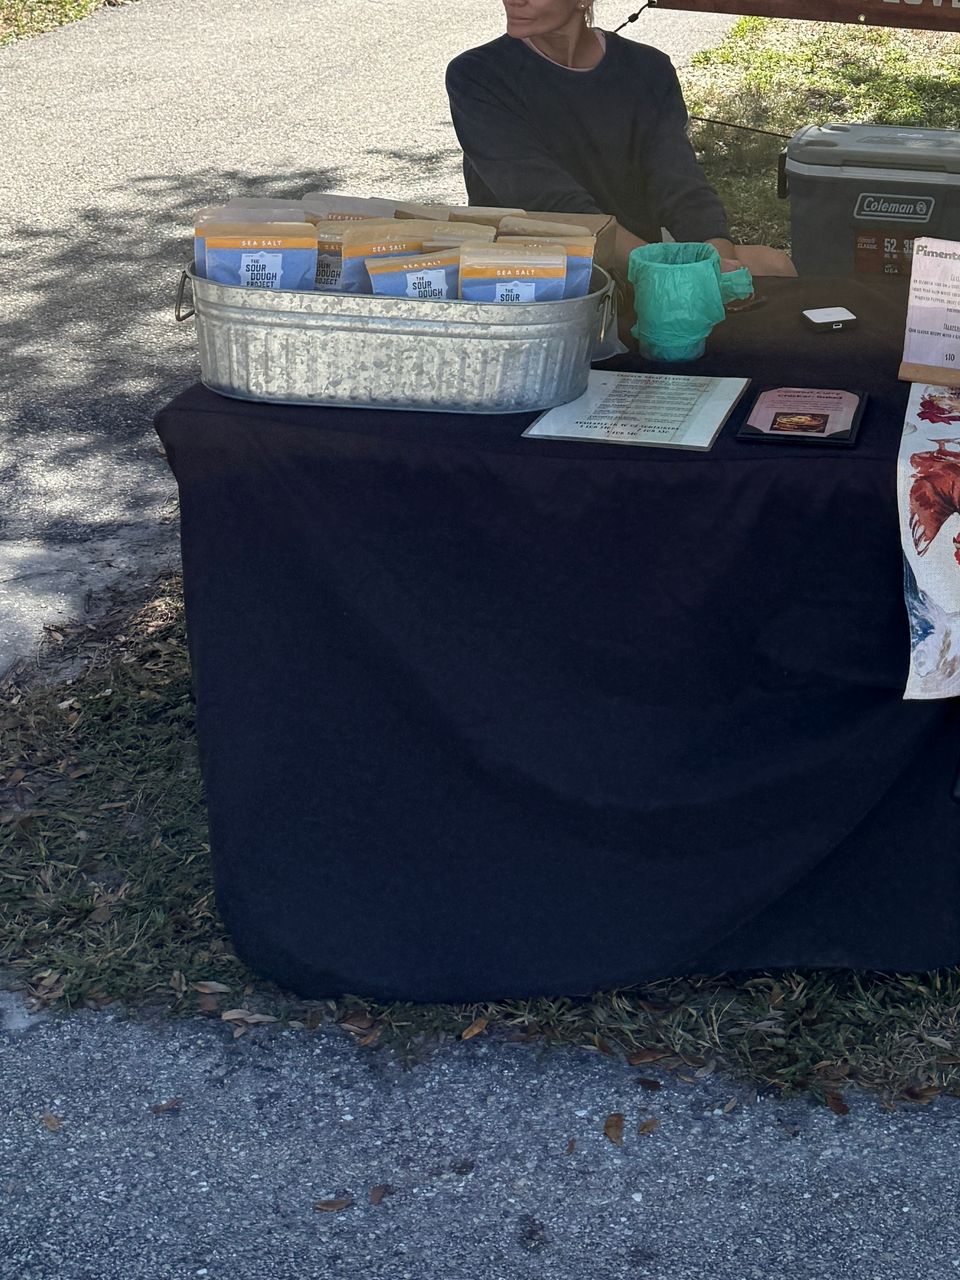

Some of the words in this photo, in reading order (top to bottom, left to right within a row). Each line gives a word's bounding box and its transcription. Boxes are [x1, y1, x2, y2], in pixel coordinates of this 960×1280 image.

[864, 197, 914, 213] Coleman
[884, 238, 897, 253] 52
[245, 263, 267, 273] SOUR
[250, 272, 277, 282] DOUGH
[246, 280, 275, 289] PROJECT
[412, 280, 432, 290] SOUR
[418, 288, 443, 299] DOUGH
[500, 293, 520, 302] SOUR
